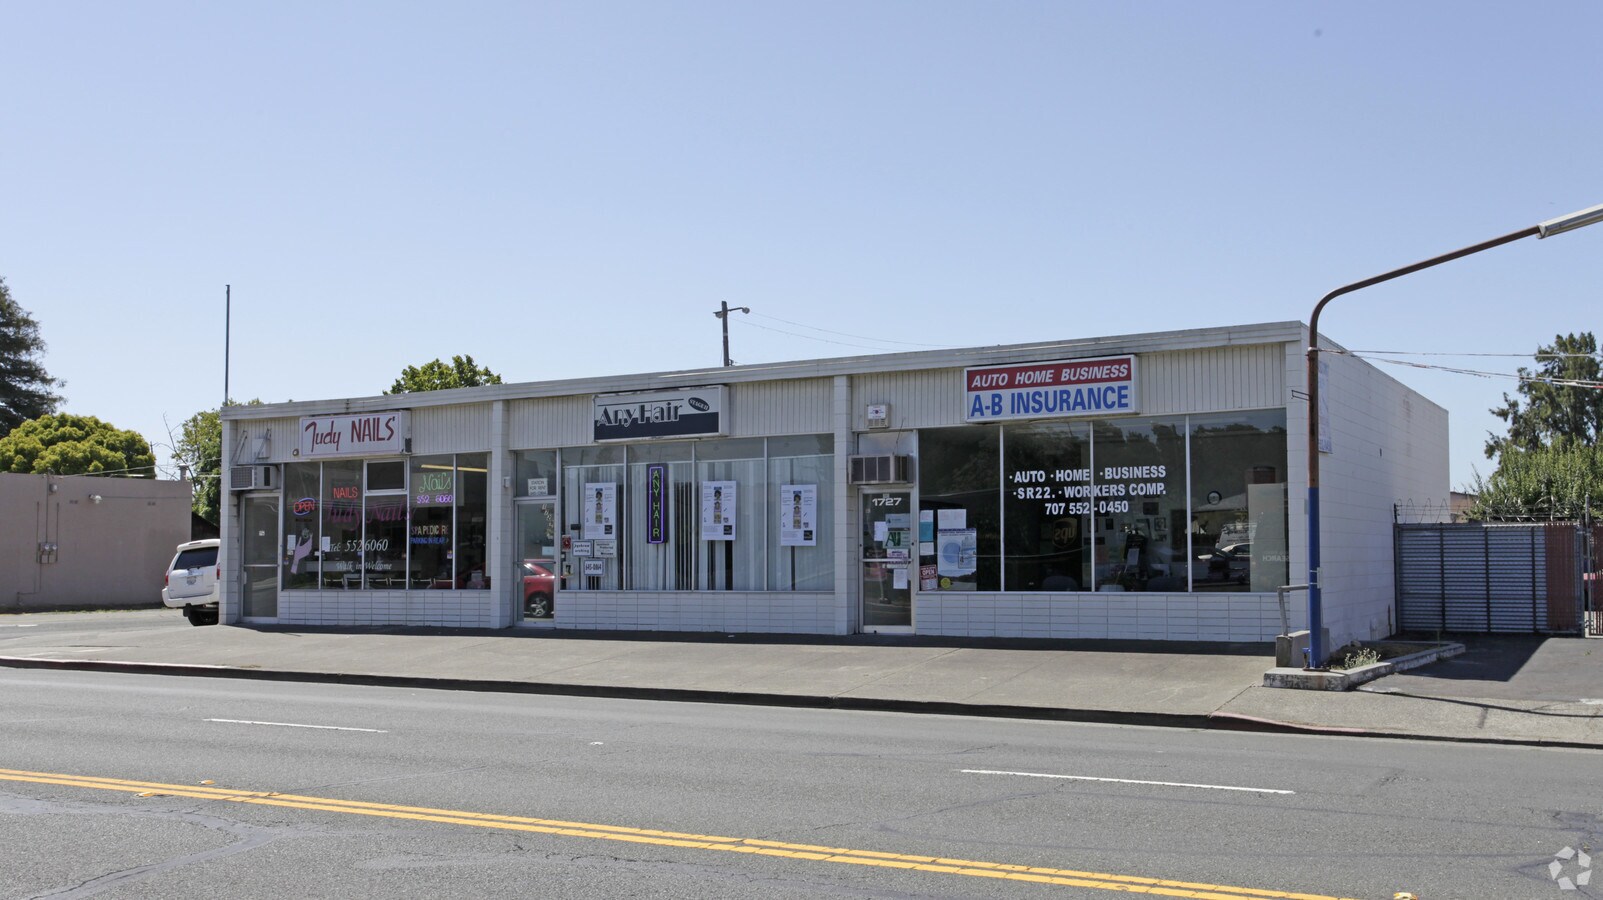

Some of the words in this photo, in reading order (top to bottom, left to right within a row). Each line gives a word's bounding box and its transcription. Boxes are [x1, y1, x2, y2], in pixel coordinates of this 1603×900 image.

[971, 373, 1008, 388] AUTO
[1015, 370, 1054, 385] HOME
[1060, 364, 1128, 382] BUSINESS
[970, 393, 1003, 417] A-B
[1010, 385, 1129, 415] INSURANCE
[597, 406, 636, 427] Any
[638, 402, 683, 424] Hair
[1014, 470, 1046, 483] AUTO
[1055, 469, 1090, 482] HOME
[1104, 465, 1166, 480] BUSINESS
[333, 486, 358, 499] NAILS
[1063, 484, 1126, 498] WORKERS
[1128, 482, 1167, 496] COMP.
[293, 501, 315, 513] OPEN
[872, 497, 902, 507] 1727
[1045, 503, 1066, 515] 707
[652, 502, 660, 538] HAIR
[422, 525, 449, 535] PEDICRE
